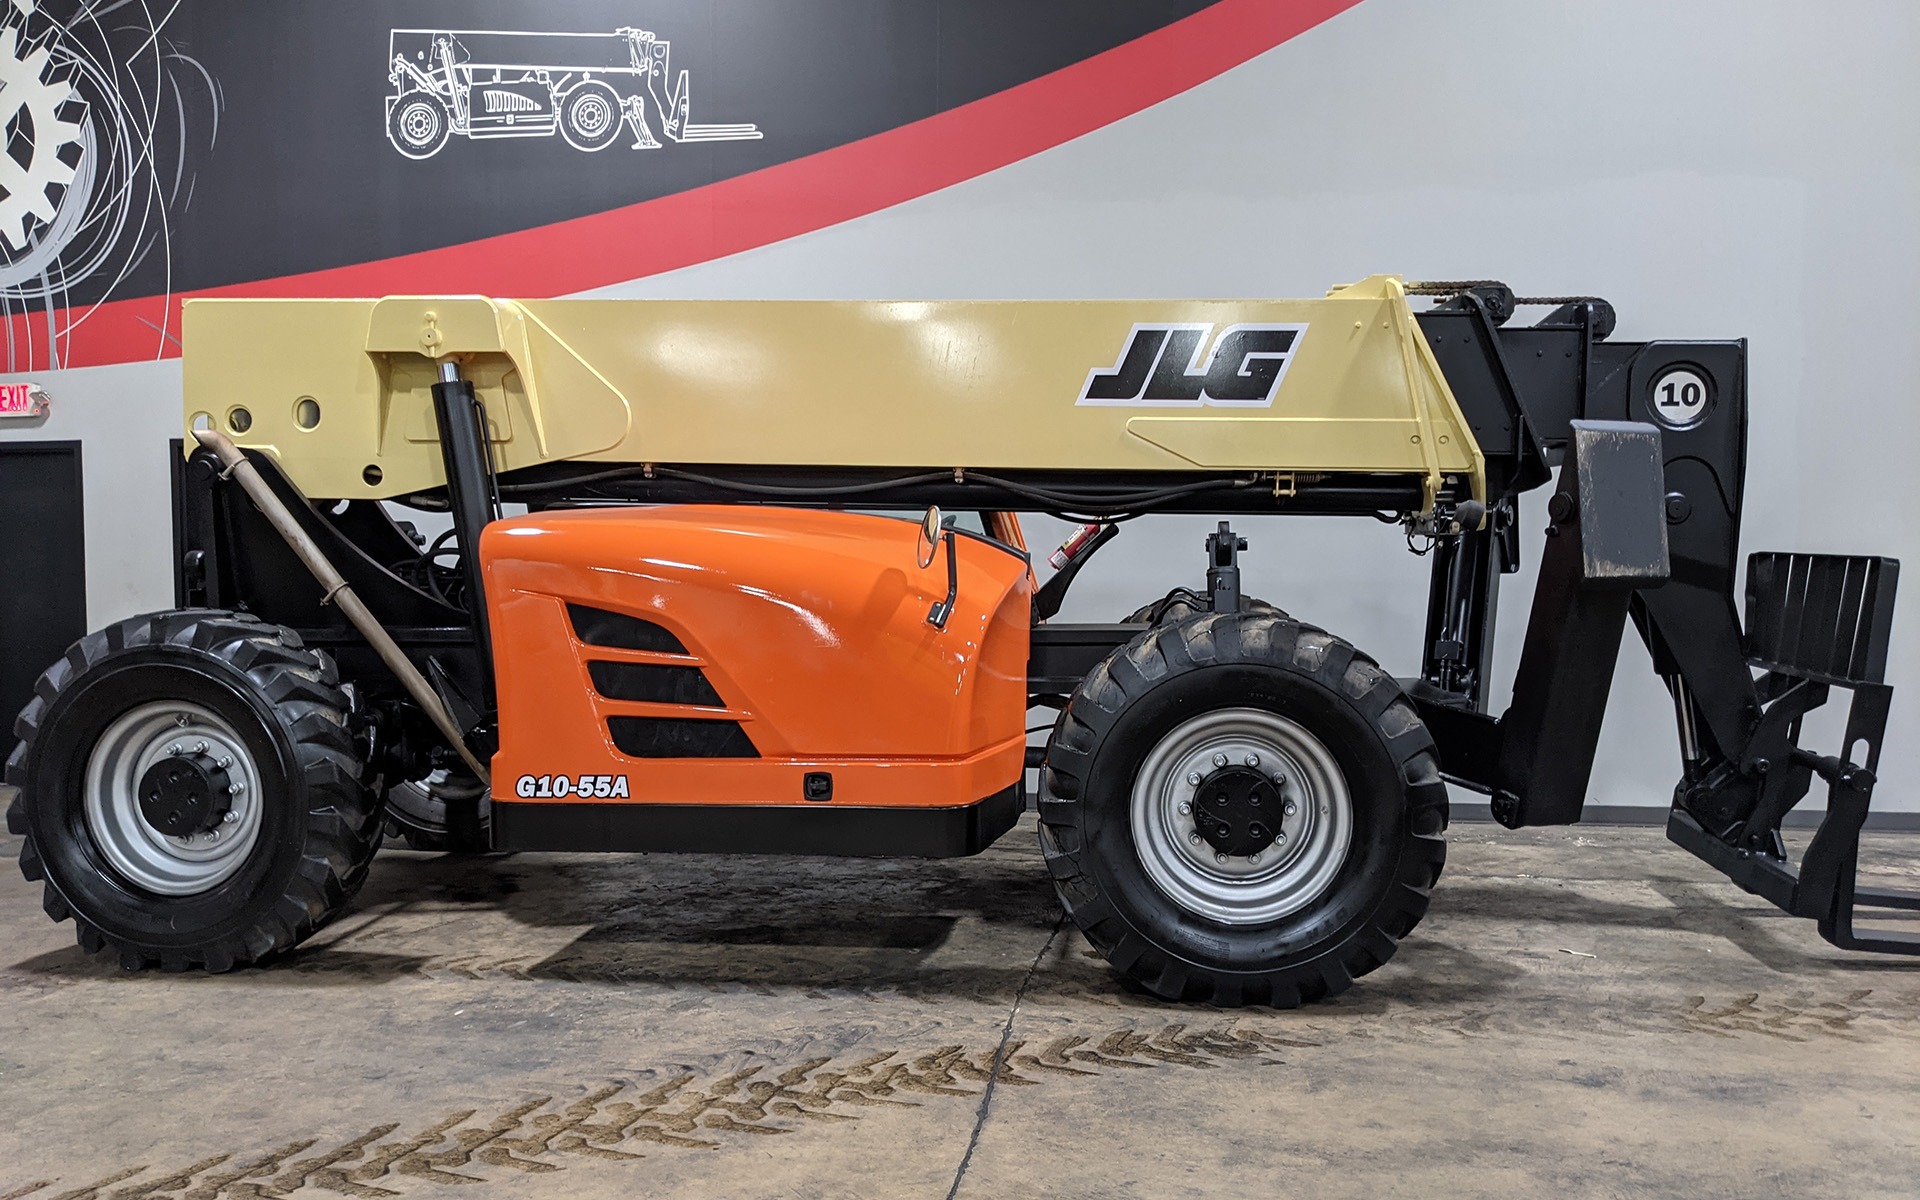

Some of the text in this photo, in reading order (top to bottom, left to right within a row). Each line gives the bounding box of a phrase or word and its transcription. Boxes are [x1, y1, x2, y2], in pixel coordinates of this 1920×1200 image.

[1080, 326, 1304, 404] JLG
[0, 385, 28, 411] EXIT
[1660, 382, 1701, 407] 10
[516, 774, 630, 798] G10-55A
